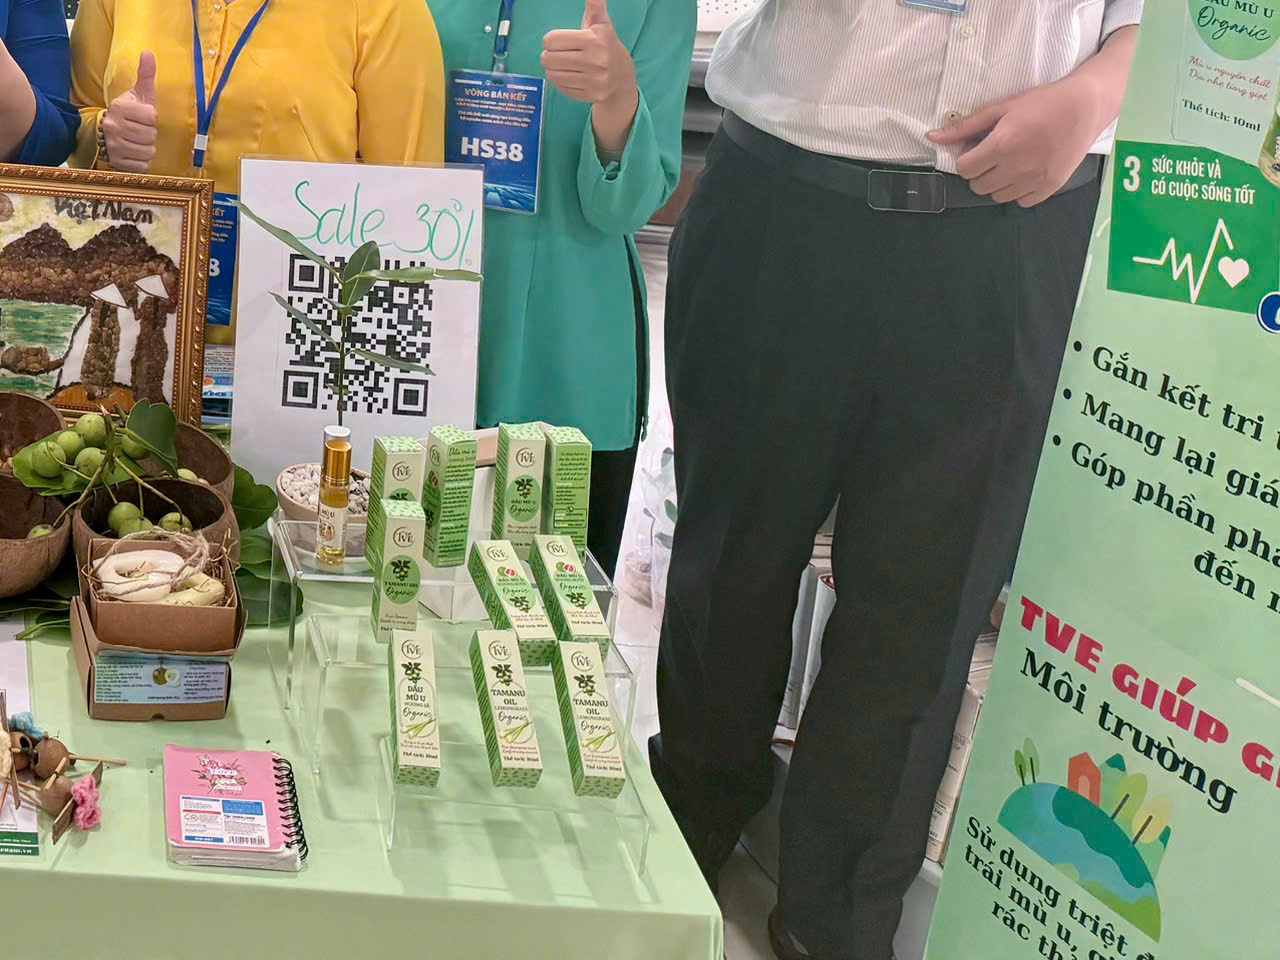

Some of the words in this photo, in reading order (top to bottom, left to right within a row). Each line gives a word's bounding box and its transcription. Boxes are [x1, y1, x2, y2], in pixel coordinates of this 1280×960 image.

[1197, 6, 1271, 41] Organic
[1264, 7, 1275, 19] U
[464, 87, 490, 98] VÒNG
[1205, 107, 1230, 122] tích:
[1233, 116, 1261, 132] 10ml
[461, 136, 524, 162] HS38
[1123, 155, 1141, 192] 3
[1152, 154, 1173, 174] SỨC
[1176, 157, 1205, 177] KHỎE
[1207, 159, 1222, 180] VÀ
[1151, 179, 1166, 195] CÓ
[1169, 180, 1199, 201] CUỘC
[1202, 181, 1232, 203] SỐNG
[1234, 184, 1255, 205] TỐT
[294, 180, 388, 249] Sale
[1092, 346, 1149, 391] Gắn
[1157, 373, 1211, 418] kết
[1221, 403, 1265, 442] tri
[1080, 392, 1165, 456] Mang
[1172, 436, 1217, 478] lại
[1071, 441, 1127, 490] Góp
[1132, 478, 1217, 535] phần
[510, 504, 537, 516] Organic
[560, 582, 587, 592] Organic
[1193, 549, 1256, 601] đến
[385, 586, 413, 600] Organic
[503, 586, 529, 596] Organic
[1020, 595, 1105, 675] TVE
[1111, 663, 1231, 745] GIÚP
[491, 689, 526, 697] TAMANU
[573, 698, 609, 707] TAMANU
[402, 707, 432, 720] Organic
[498, 711, 529, 725] Organic
[580, 720, 610, 735] Organic
[1019, 647, 1089, 716] Môi
[1097, 701, 1239, 815] trường
[965, 844, 1004, 891] trái
[1008, 885, 1048, 927] mù
[966, 816, 996, 853] Sử
[999, 847, 1062, 909] dụng
[1068, 898, 1129, 957] triệt
[991, 901, 1031, 941] rác
